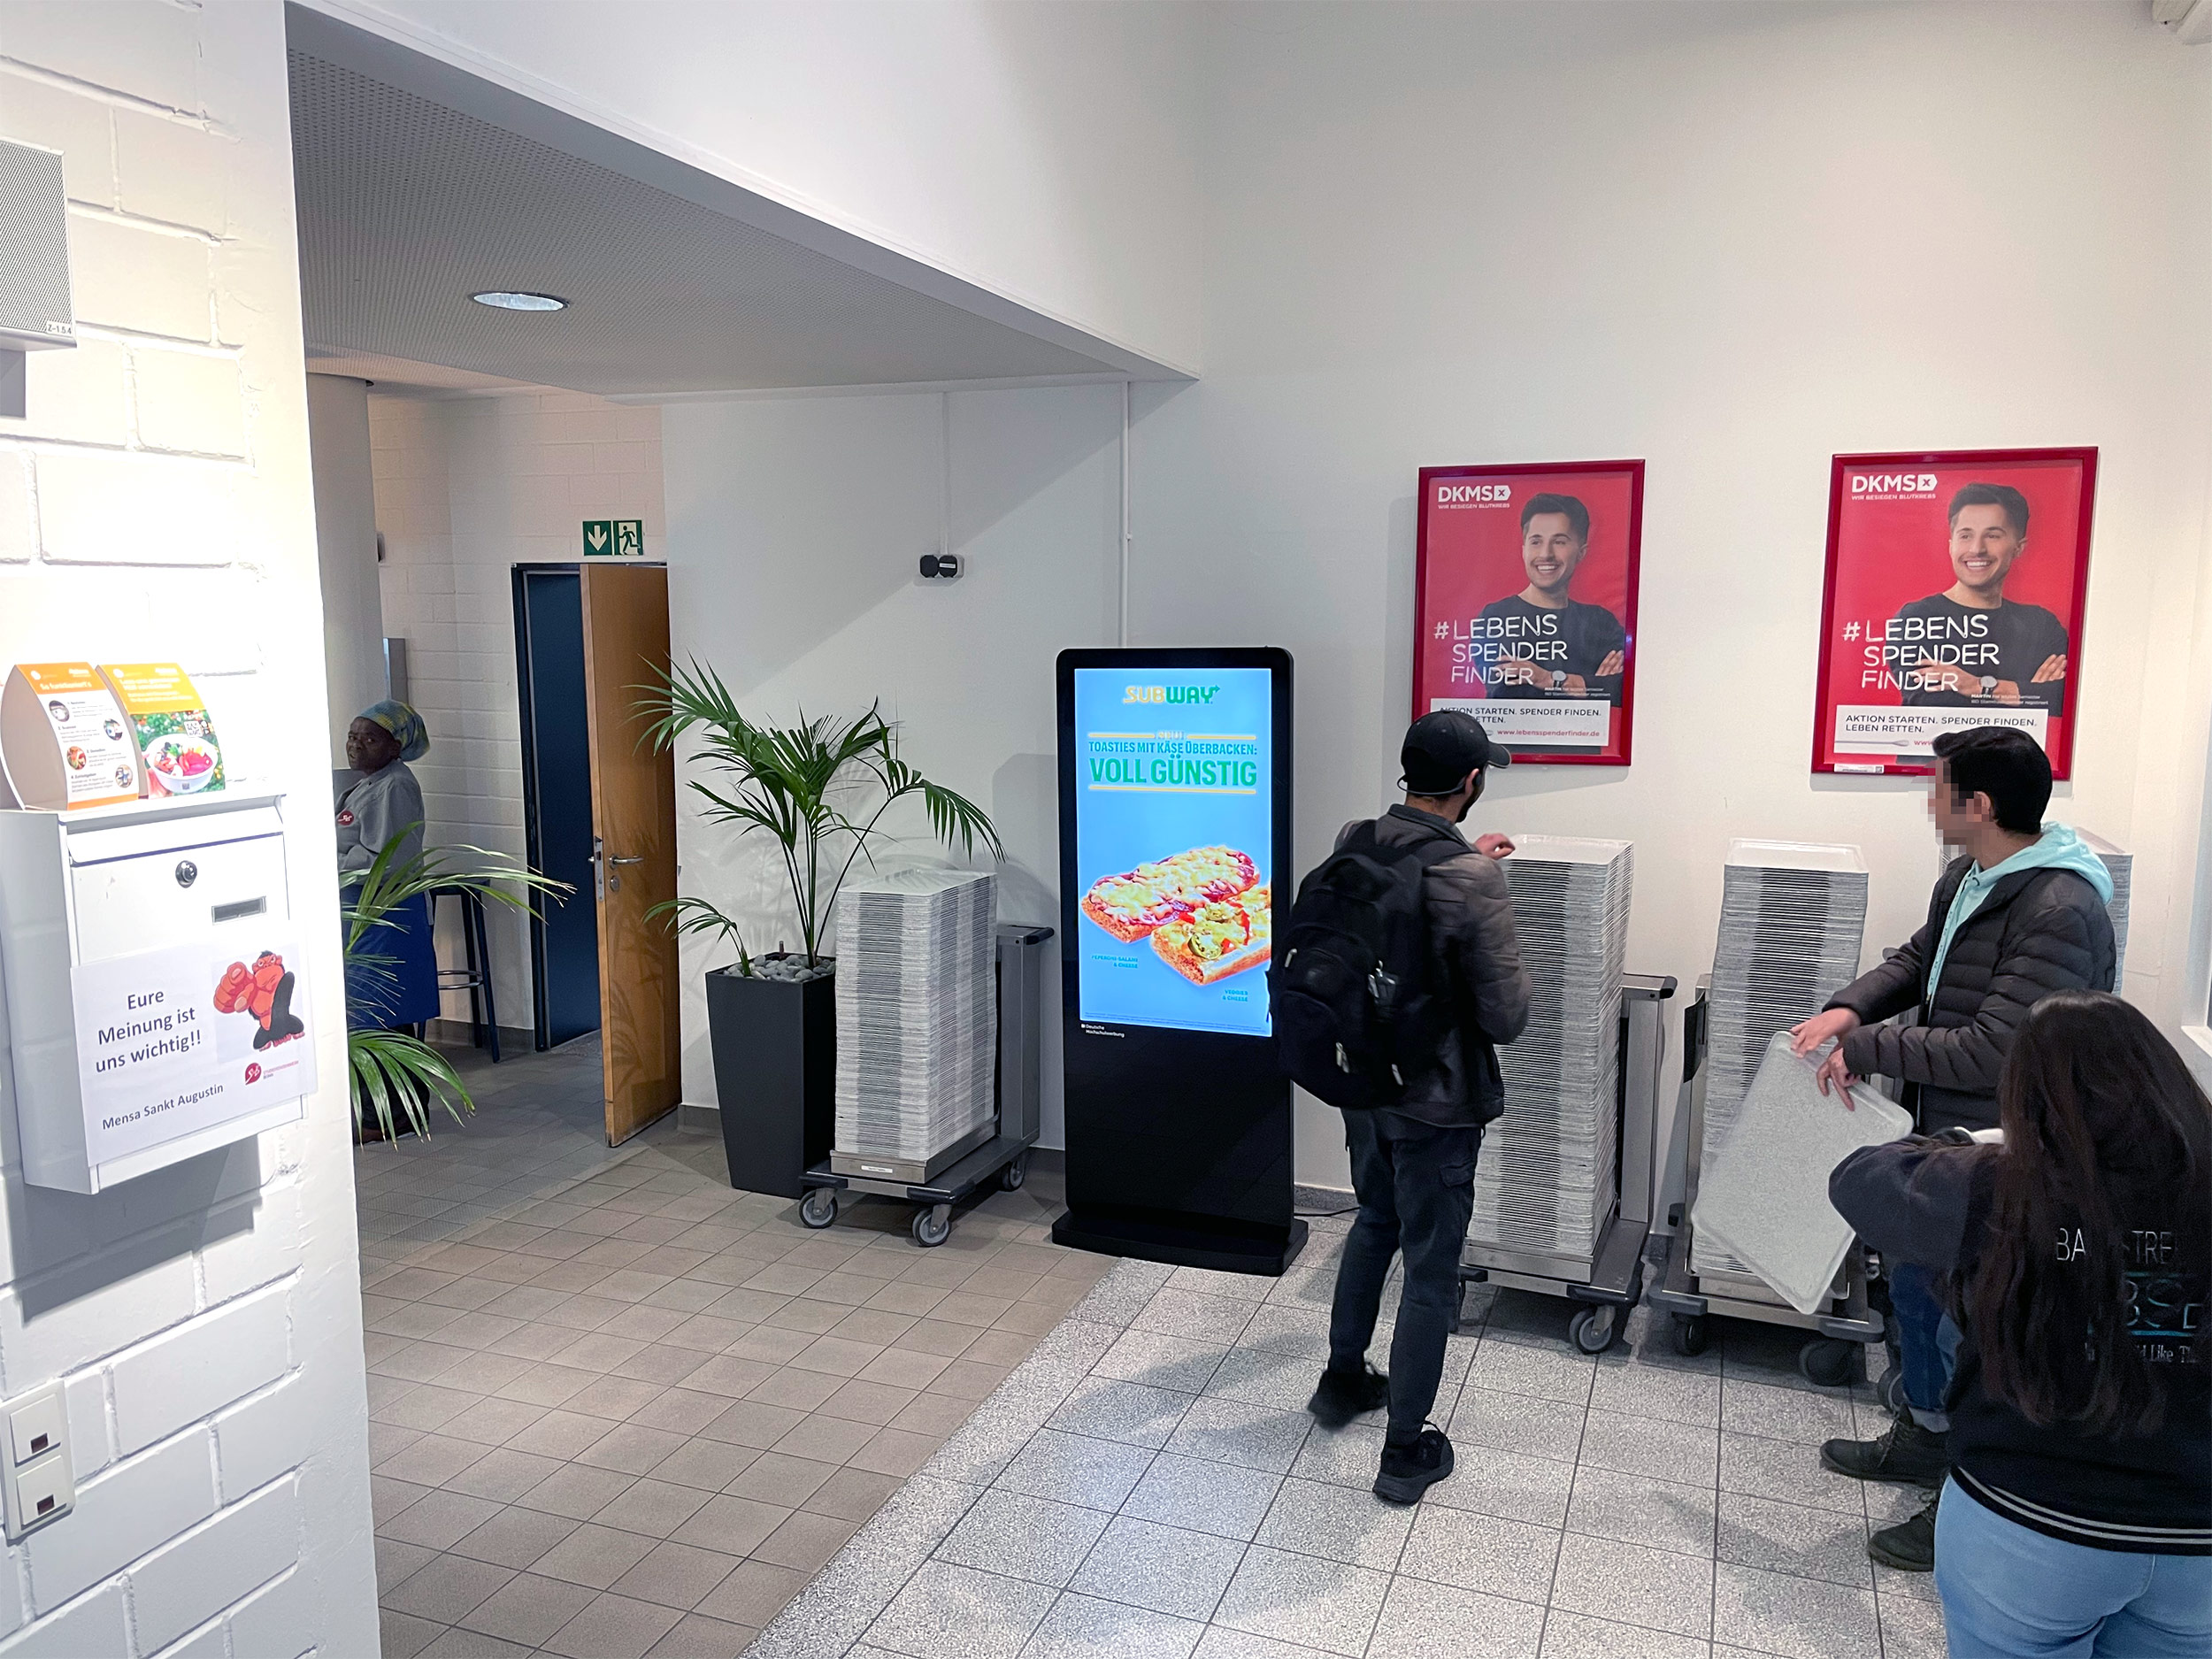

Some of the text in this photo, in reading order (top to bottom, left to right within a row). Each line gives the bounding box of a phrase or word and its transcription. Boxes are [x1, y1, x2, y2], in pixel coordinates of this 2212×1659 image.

[1852, 474, 1916, 493] DKMS
[1438, 485, 1494, 503] DKMS
[1452, 640, 1569, 663] SPENDER
[1863, 643, 2001, 667] SPENDER
[1451, 665, 1534, 686] FINDER
[1861, 670, 1959, 693] FINDER
[1123, 685, 1221, 705] SUBWAY
[1845, 724, 1924, 733] LEBEN RETTEN.
[1846, 715, 2037, 726] AKTION STARTEN. SPENDER FINDEN.
[1497, 728, 1600, 737] www.lebensspenderfinder.de
[1088, 741, 1257, 756] TOASTIES MIT KÄSE ÜBERBACKEN:
[1089, 754, 1257, 787] VOLL GÜNSTIG
[127, 990, 165, 1010] Eure
[97, 1007, 196, 1045] Meinung ist
[96, 1029, 202, 1073] uns wichtig!!
[102, 1084, 224, 1130] Mensa Sankt Augustin
